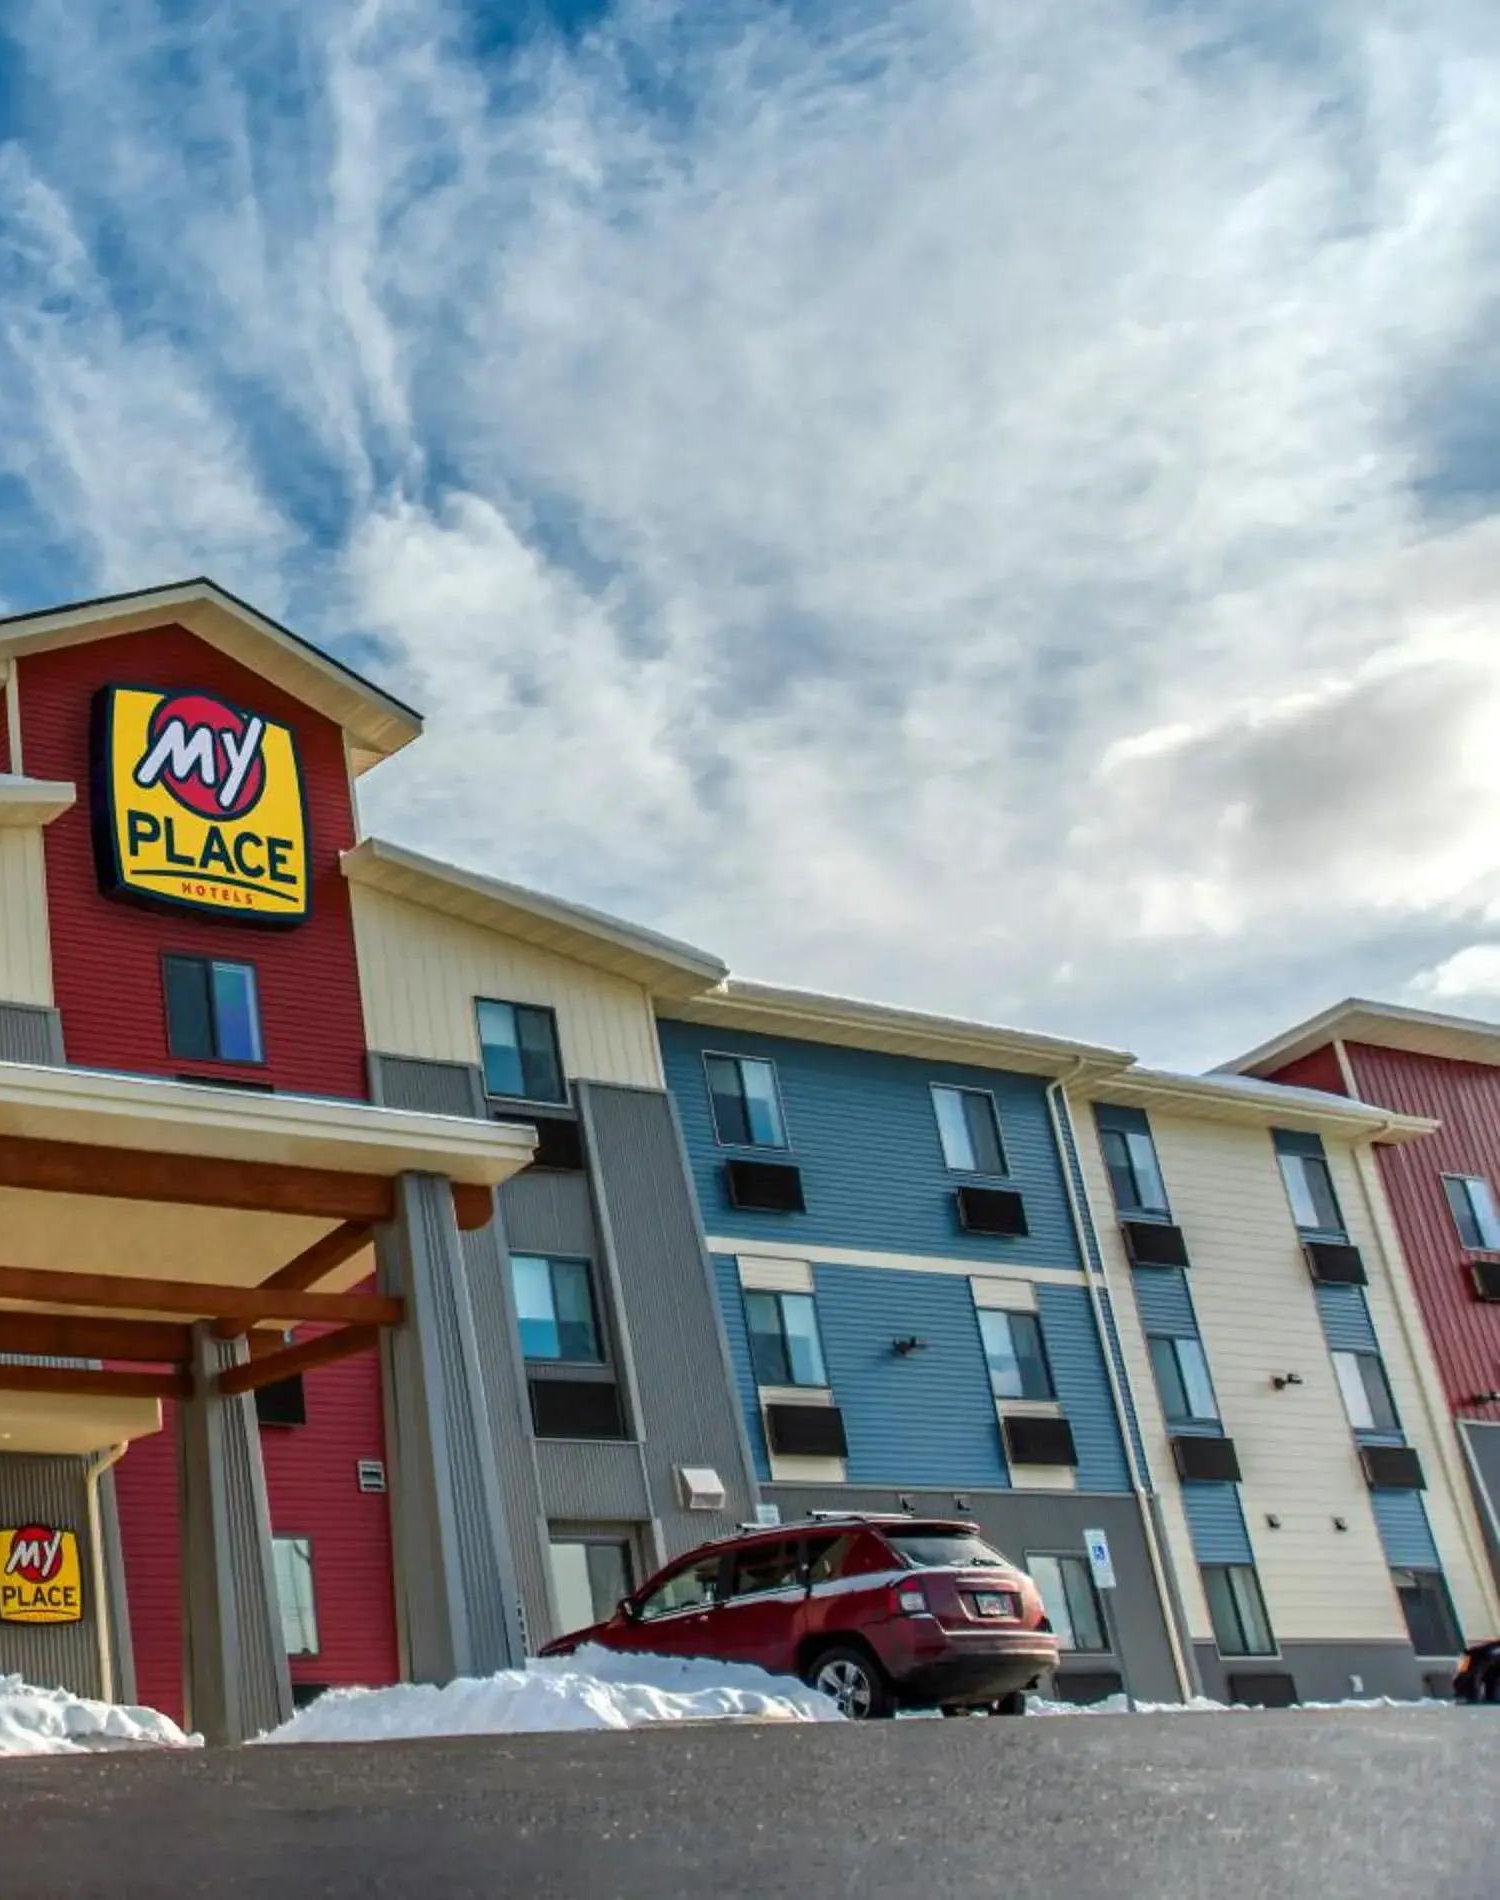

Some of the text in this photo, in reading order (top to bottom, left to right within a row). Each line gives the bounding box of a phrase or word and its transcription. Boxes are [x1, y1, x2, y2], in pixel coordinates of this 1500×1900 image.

[127, 808, 298, 885] PLACE
[181, 881, 253, 905] HOTELS
[2, 1585, 77, 1607] PLACE
